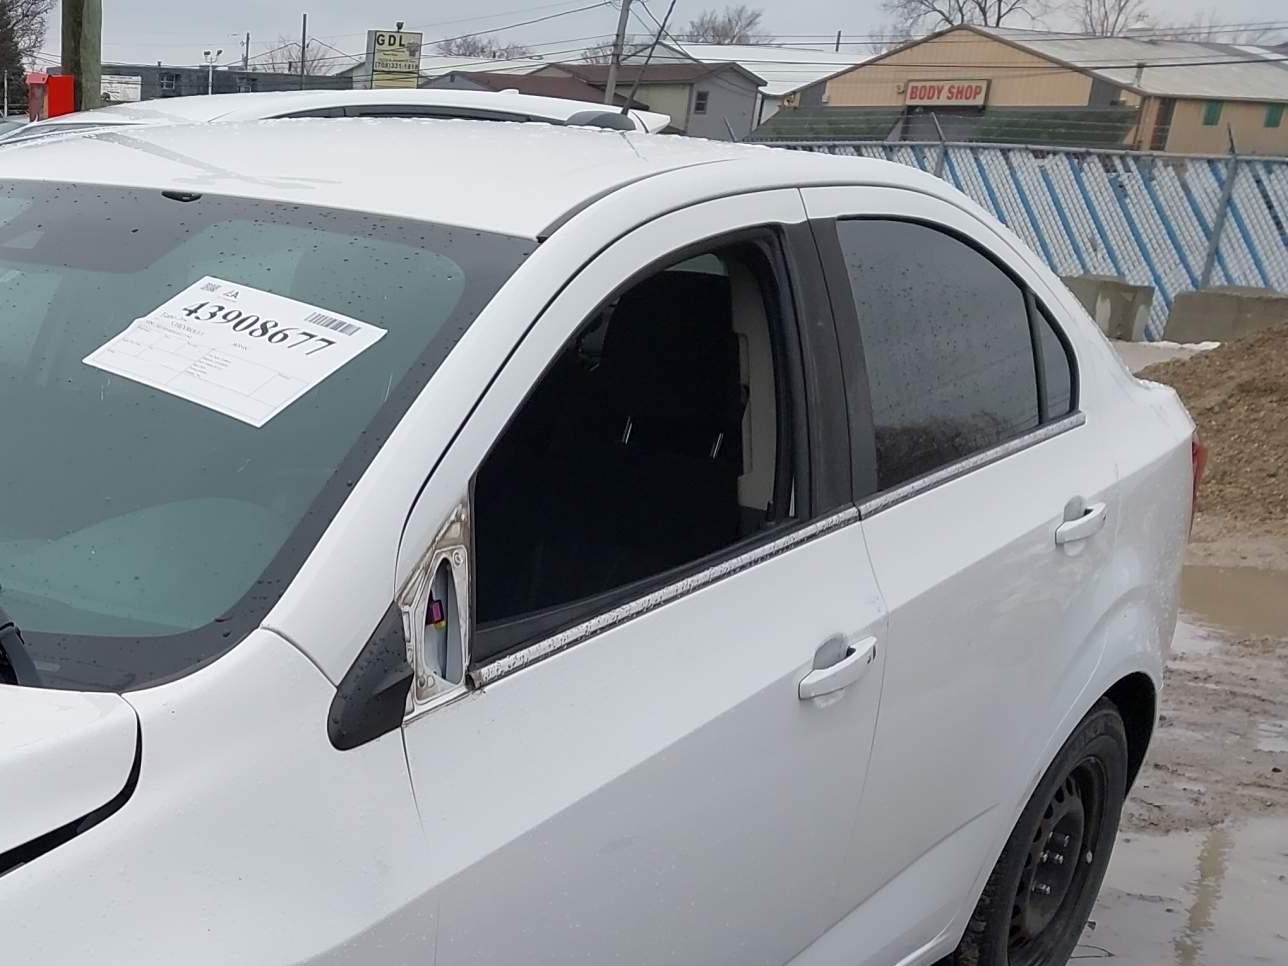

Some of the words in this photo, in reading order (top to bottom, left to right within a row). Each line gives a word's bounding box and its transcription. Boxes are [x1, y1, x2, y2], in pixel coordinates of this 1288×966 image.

[376, 34, 406, 47] GDL
[909, 85, 945, 100] BODY
[946, 85, 983, 100] SHOP
[182, 301, 336, 356] 43908677
